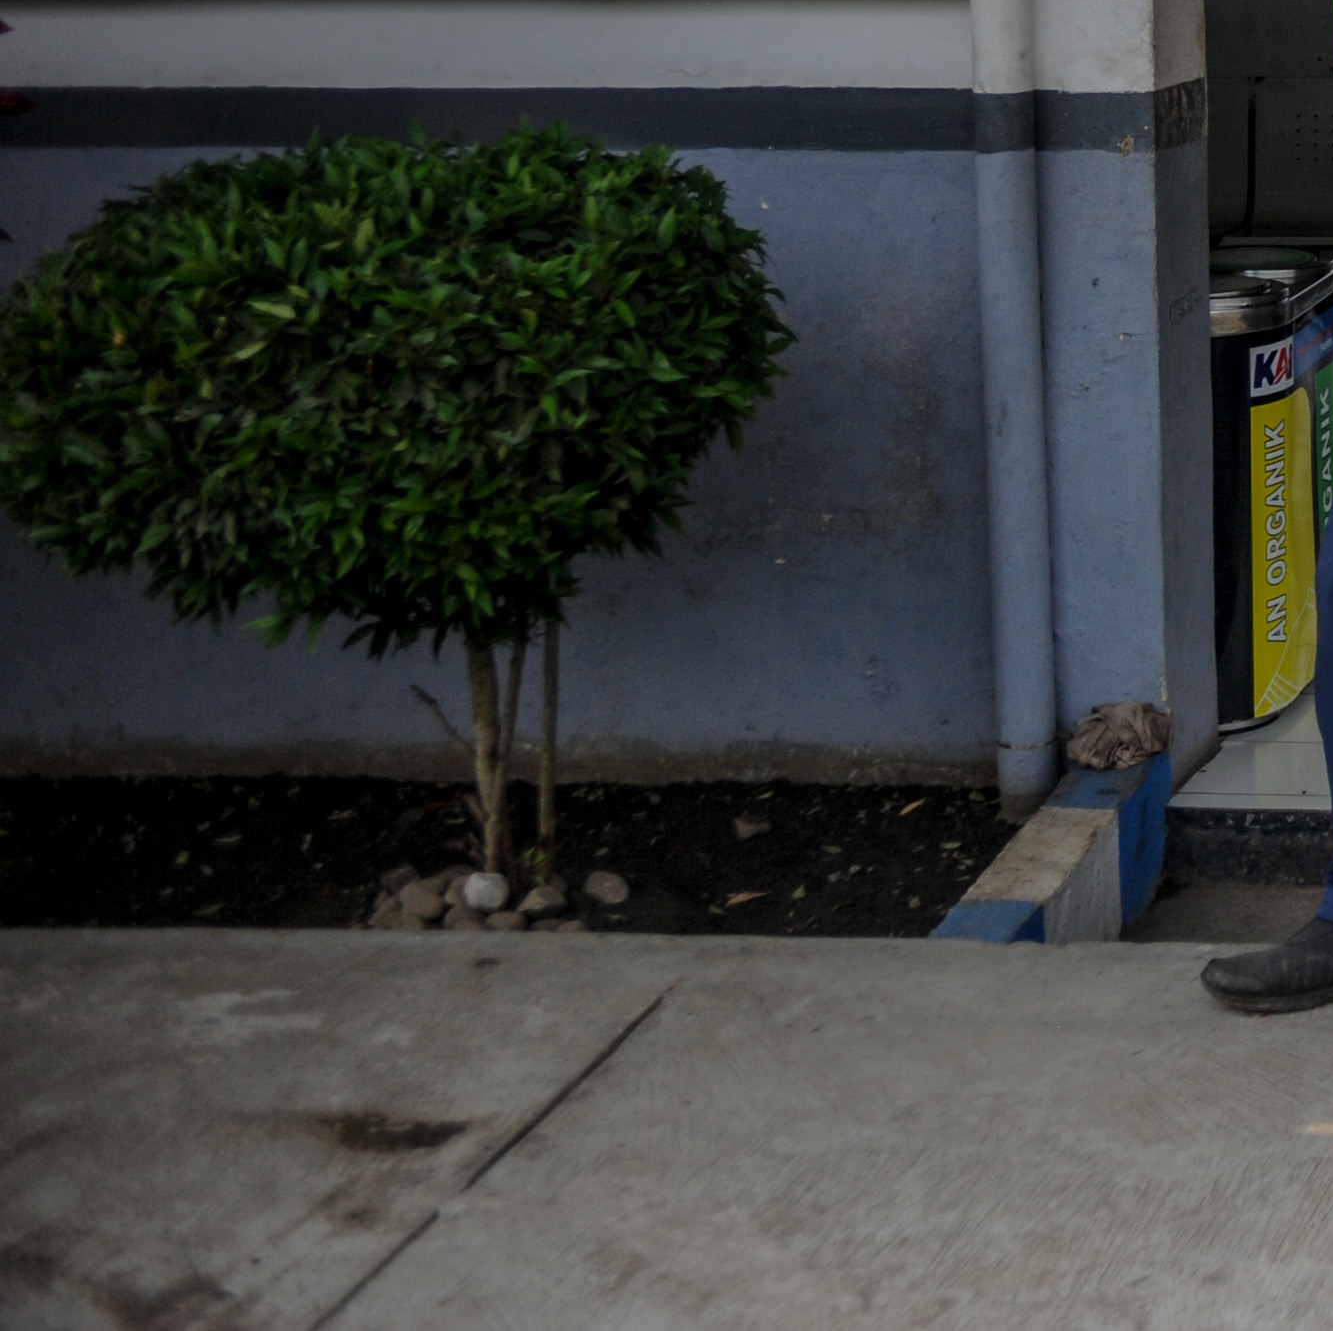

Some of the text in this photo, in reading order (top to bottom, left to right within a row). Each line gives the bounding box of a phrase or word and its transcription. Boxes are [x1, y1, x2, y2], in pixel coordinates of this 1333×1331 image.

[1253, 343, 1293, 389] KAI
[1264, 418, 1288, 642] AN ORGANIK
